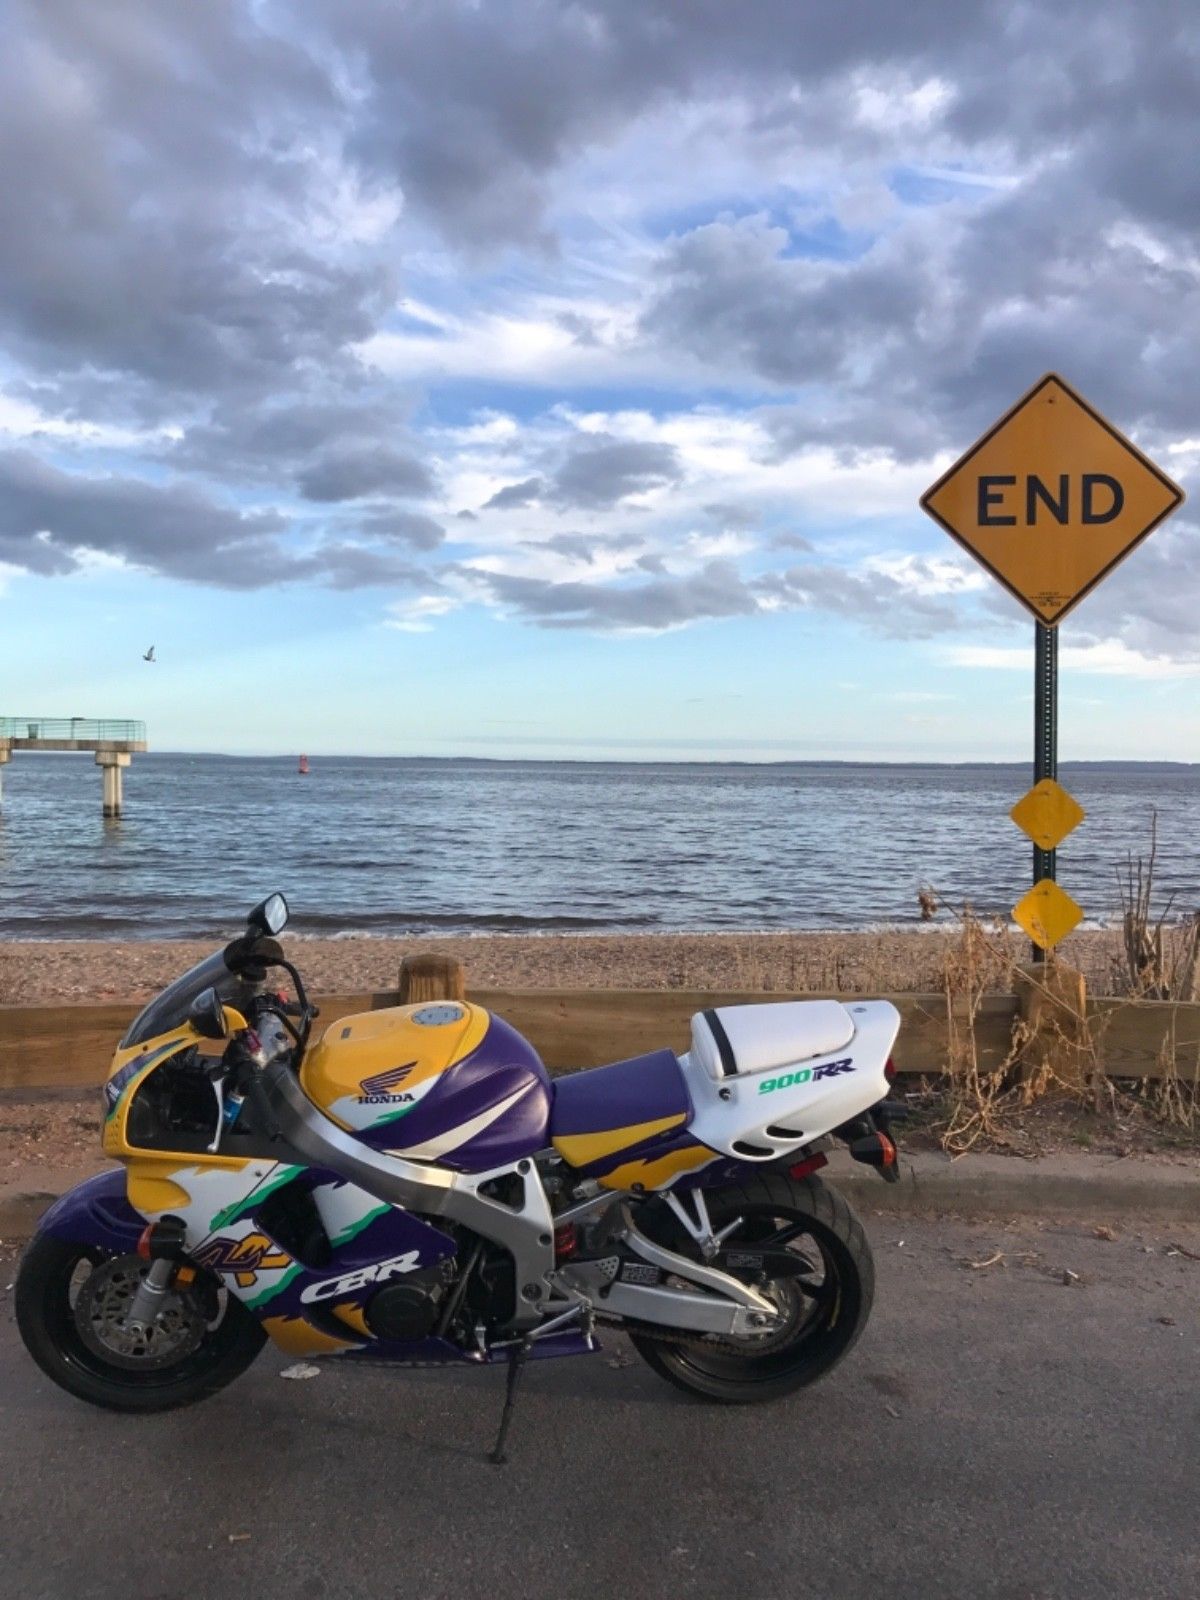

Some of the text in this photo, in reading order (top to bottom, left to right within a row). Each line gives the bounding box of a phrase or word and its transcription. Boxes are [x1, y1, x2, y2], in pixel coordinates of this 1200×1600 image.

[977, 474, 1125, 526] END
[358, 1093, 416, 1104] HONDA
[300, 1250, 422, 1304] CBR
